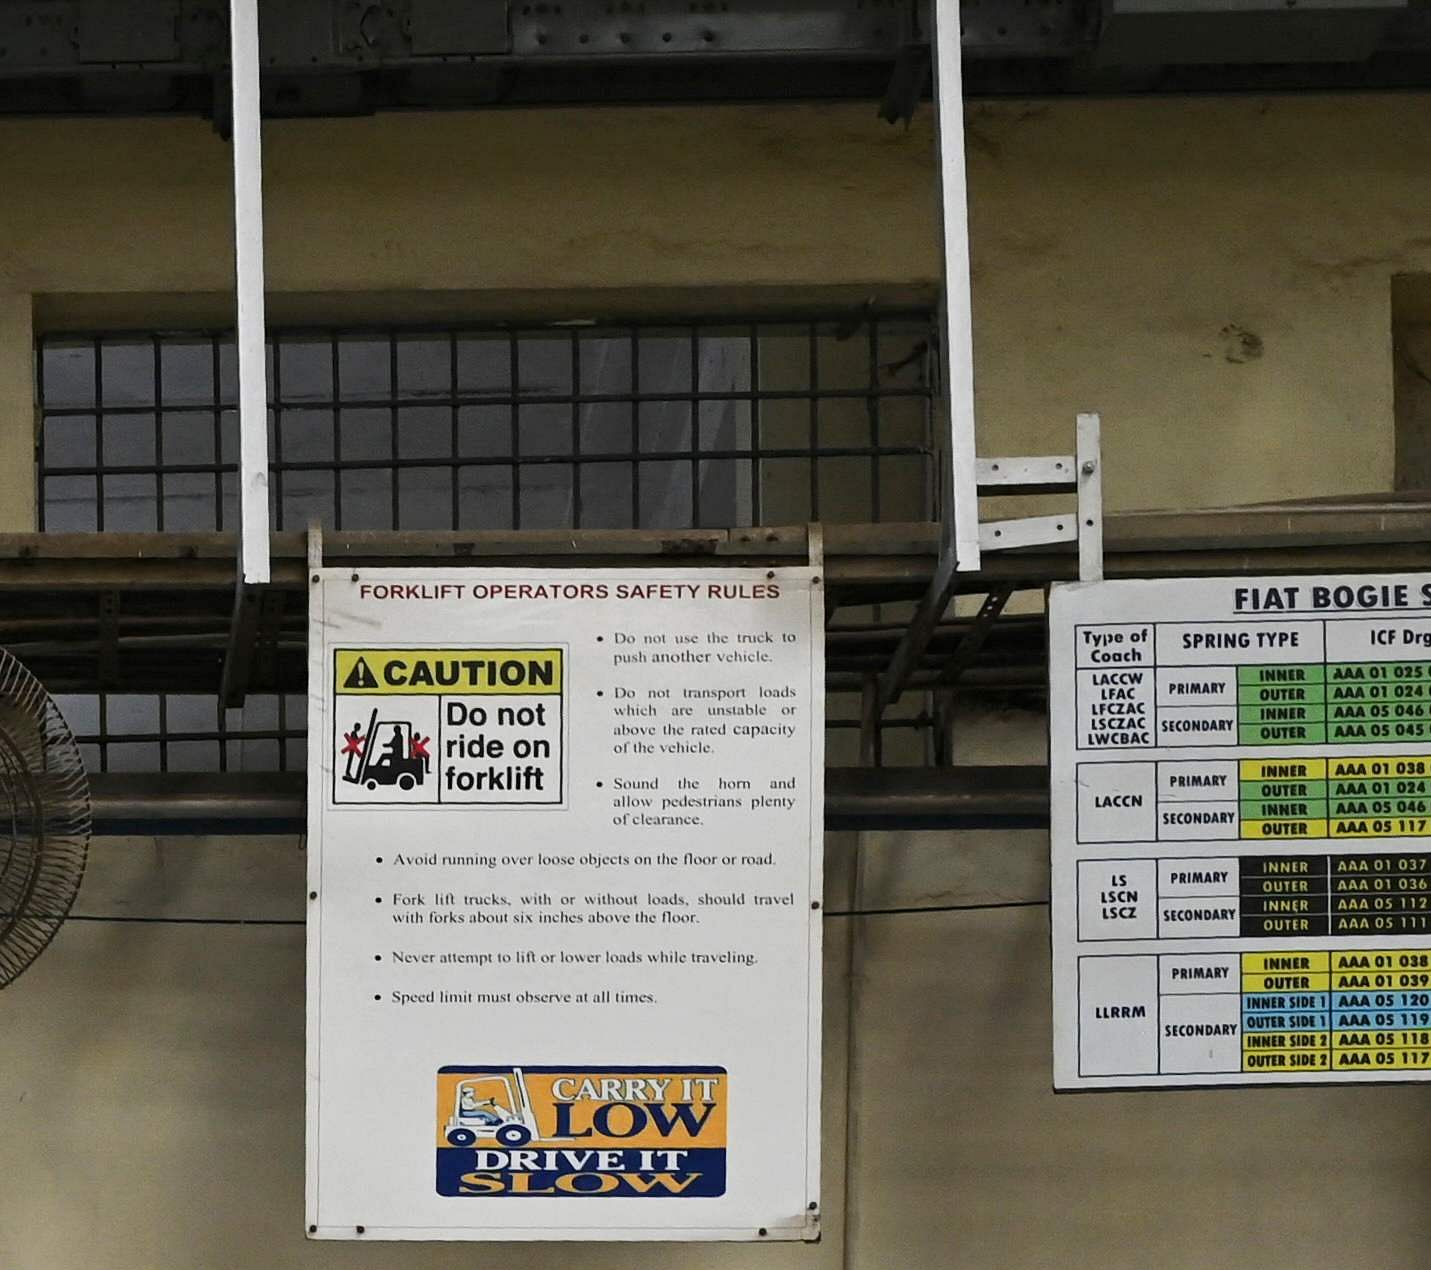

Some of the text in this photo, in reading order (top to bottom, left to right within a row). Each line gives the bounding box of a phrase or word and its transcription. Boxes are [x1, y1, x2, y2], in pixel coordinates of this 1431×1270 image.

[360, 585, 780, 599] FORKLIFT OPERATORS SAFETY RULES
[1234, 587, 1299, 610] FIAT
[1312, 584, 1407, 608] BOGIE
[614, 632, 796, 645] Do not use the truck to
[1083, 630, 1148, 648] Type of
[1182, 630, 1299, 649] SPRING TYPE
[1371, 629, 1401, 646] ICF
[614, 650, 772, 666] push another vehicle.
[1090, 647, 1142, 665] Coach
[384, 660, 553, 686] CAUTION
[1260, 670, 1307, 683] INNER
[1333, 666, 1365, 680] AAA
[1370, 665, 1390, 680] 01
[1395, 665, 1424, 679] 025
[1168, 681, 1226, 695] PRIMARY
[447, 703, 546, 727] Do not
[446, 735, 550, 758] ride on
[445, 767, 544, 791] forklift
[392, 950, 758, 966] Never attempt to lift or lower loads while traveling.
[392, 991, 657, 1005] Speed limit must observe at all times.
[551, 1078, 718, 1101] CARRY IT
[554, 1102, 717, 1138] LOW
[475, 1149, 688, 1170] DRIVE IT
[458, 1173, 703, 1193] SLOW
